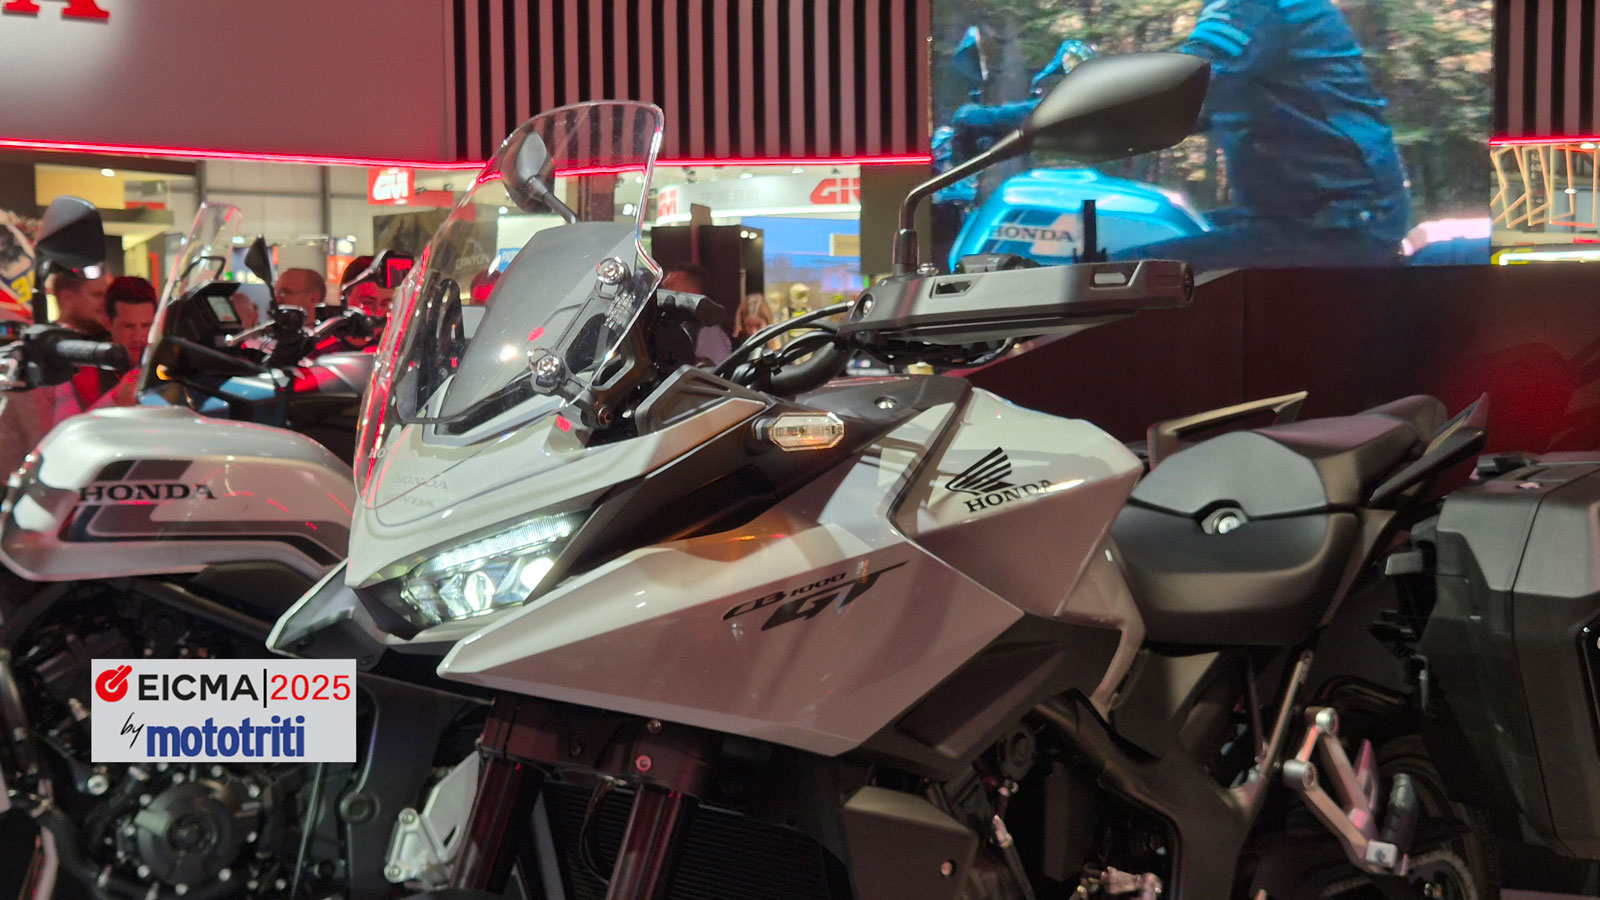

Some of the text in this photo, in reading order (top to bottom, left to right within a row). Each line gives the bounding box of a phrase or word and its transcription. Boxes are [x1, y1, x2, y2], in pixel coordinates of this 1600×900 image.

[80, 484, 216, 501] HONDA
[963, 480, 1051, 513] HONDA
[761, 560, 909, 631] GT
